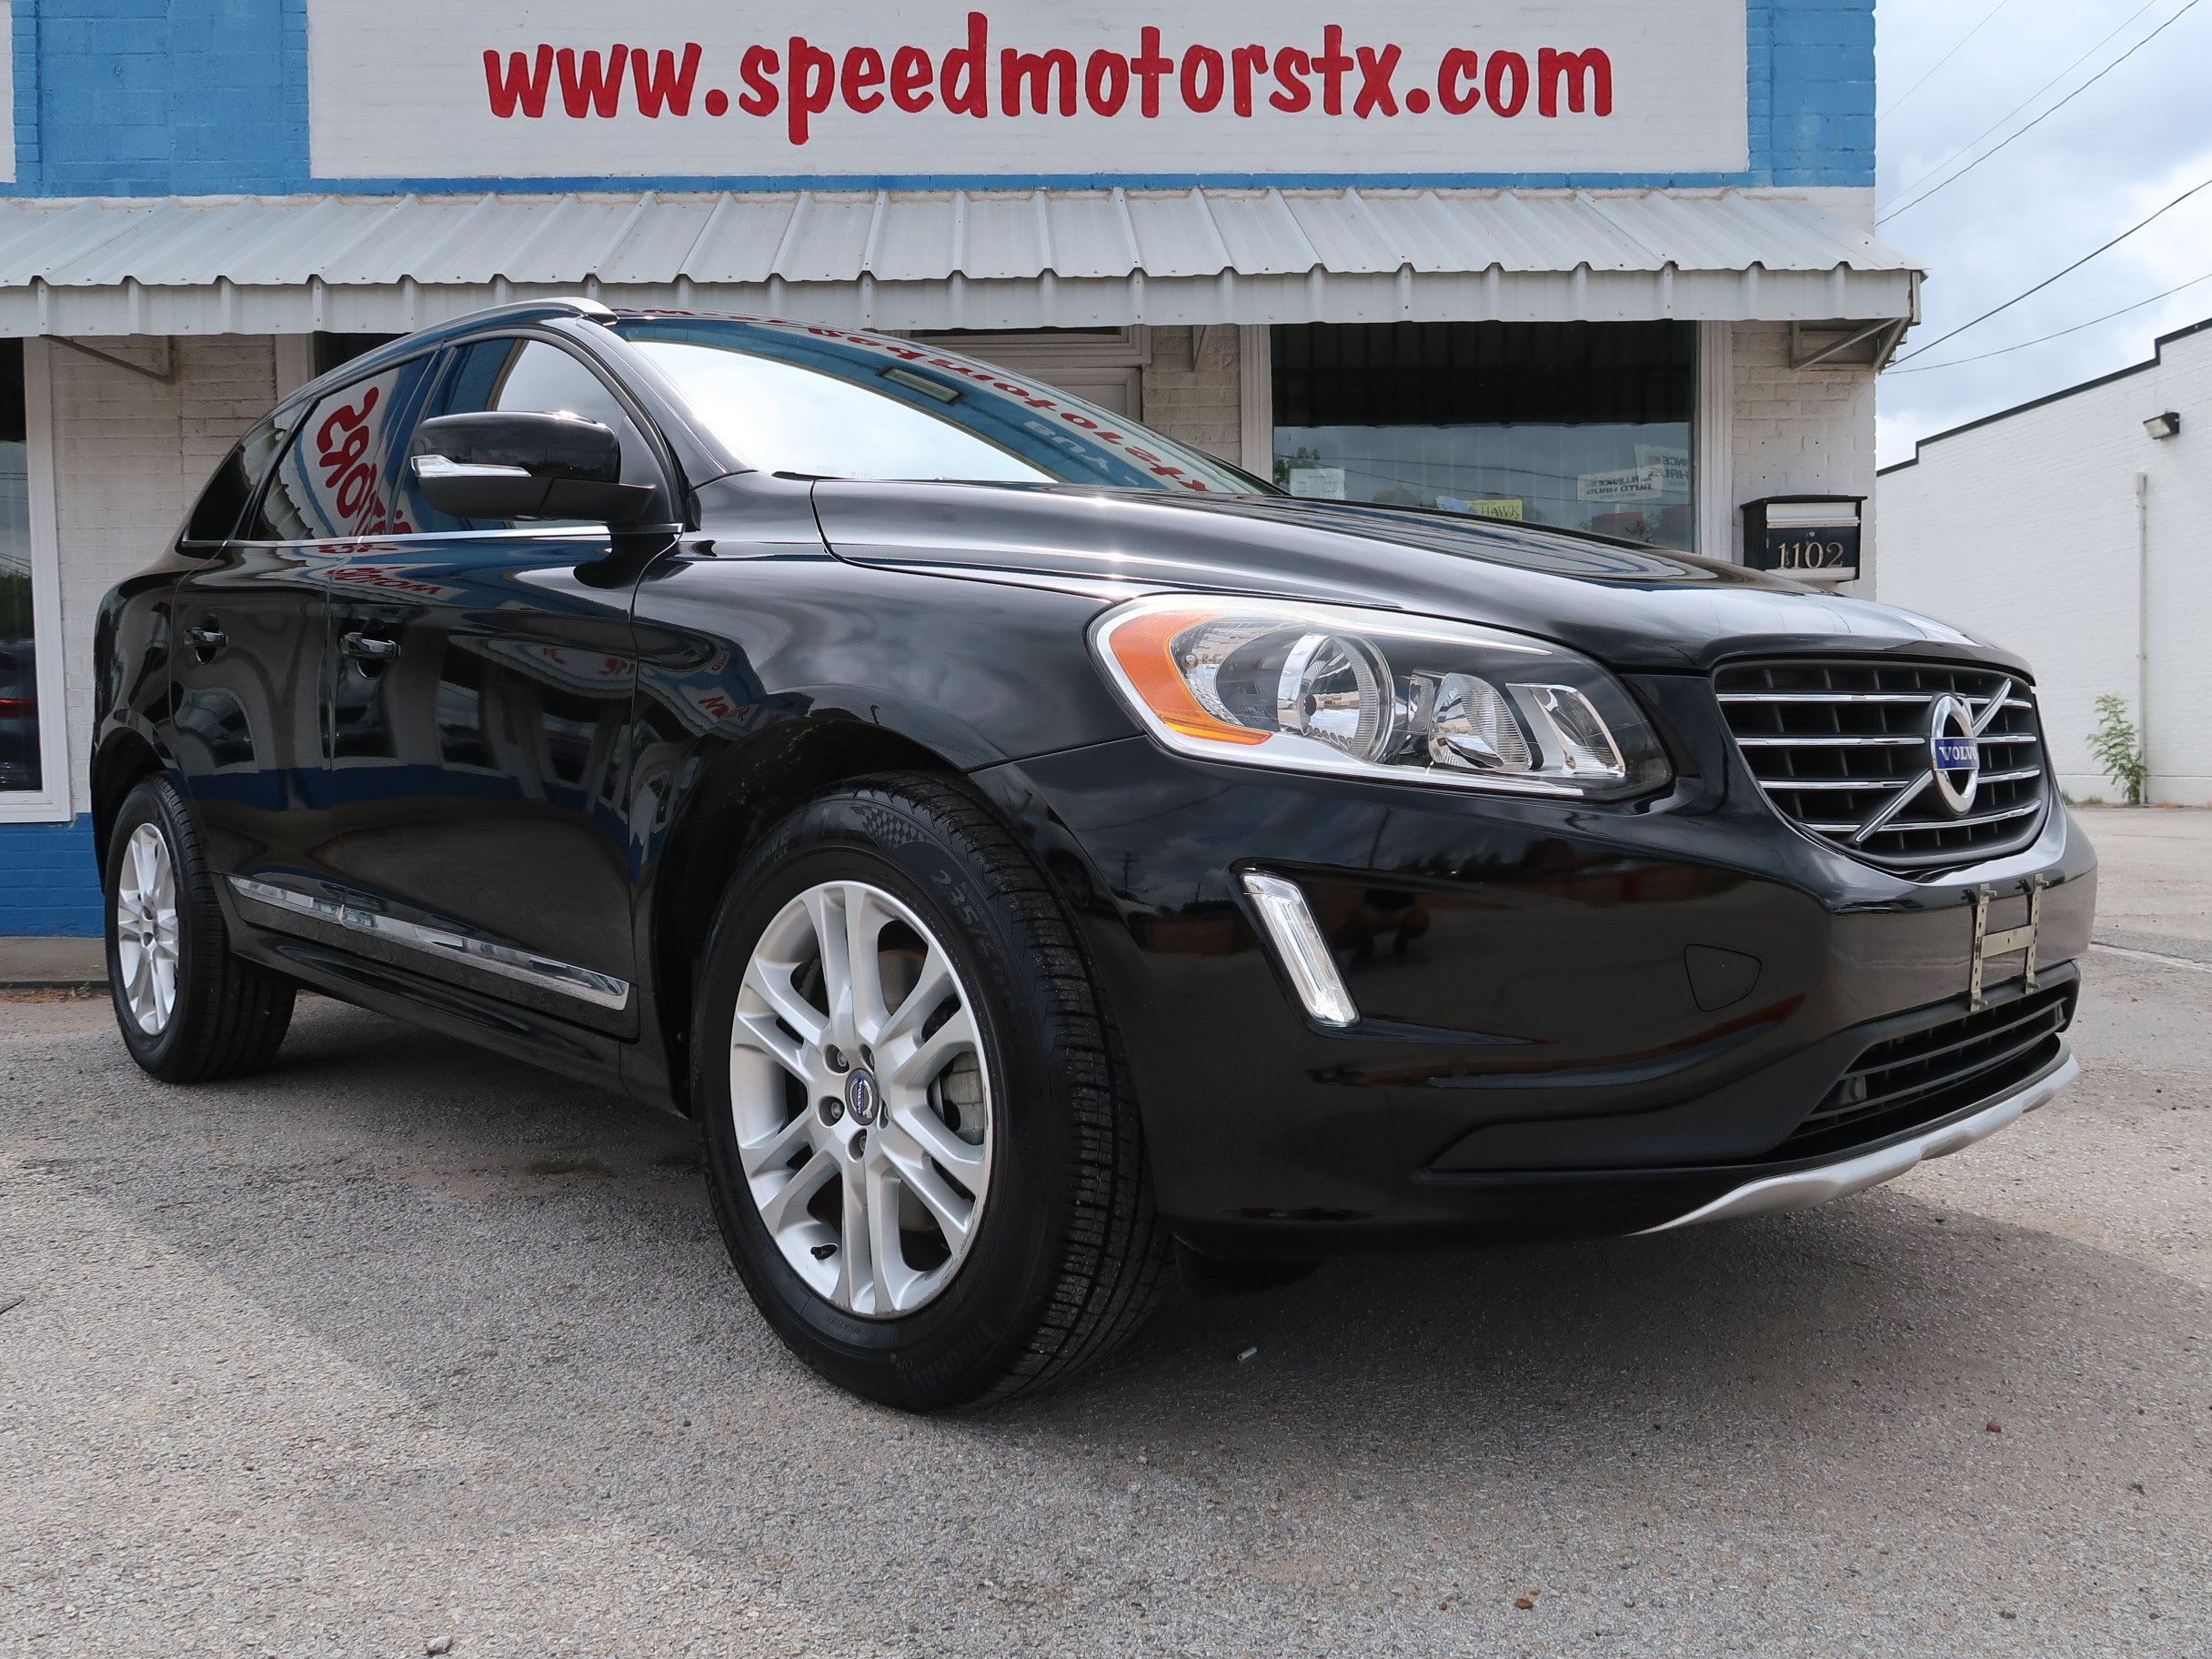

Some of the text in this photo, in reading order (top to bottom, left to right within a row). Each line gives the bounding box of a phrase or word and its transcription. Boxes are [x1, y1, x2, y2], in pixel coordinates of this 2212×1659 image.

[483, 11, 1613, 145] www.speedmotorstx.com
[1776, 541, 1844, 569] 1102
[1938, 746, 1977, 761] VOLVO
